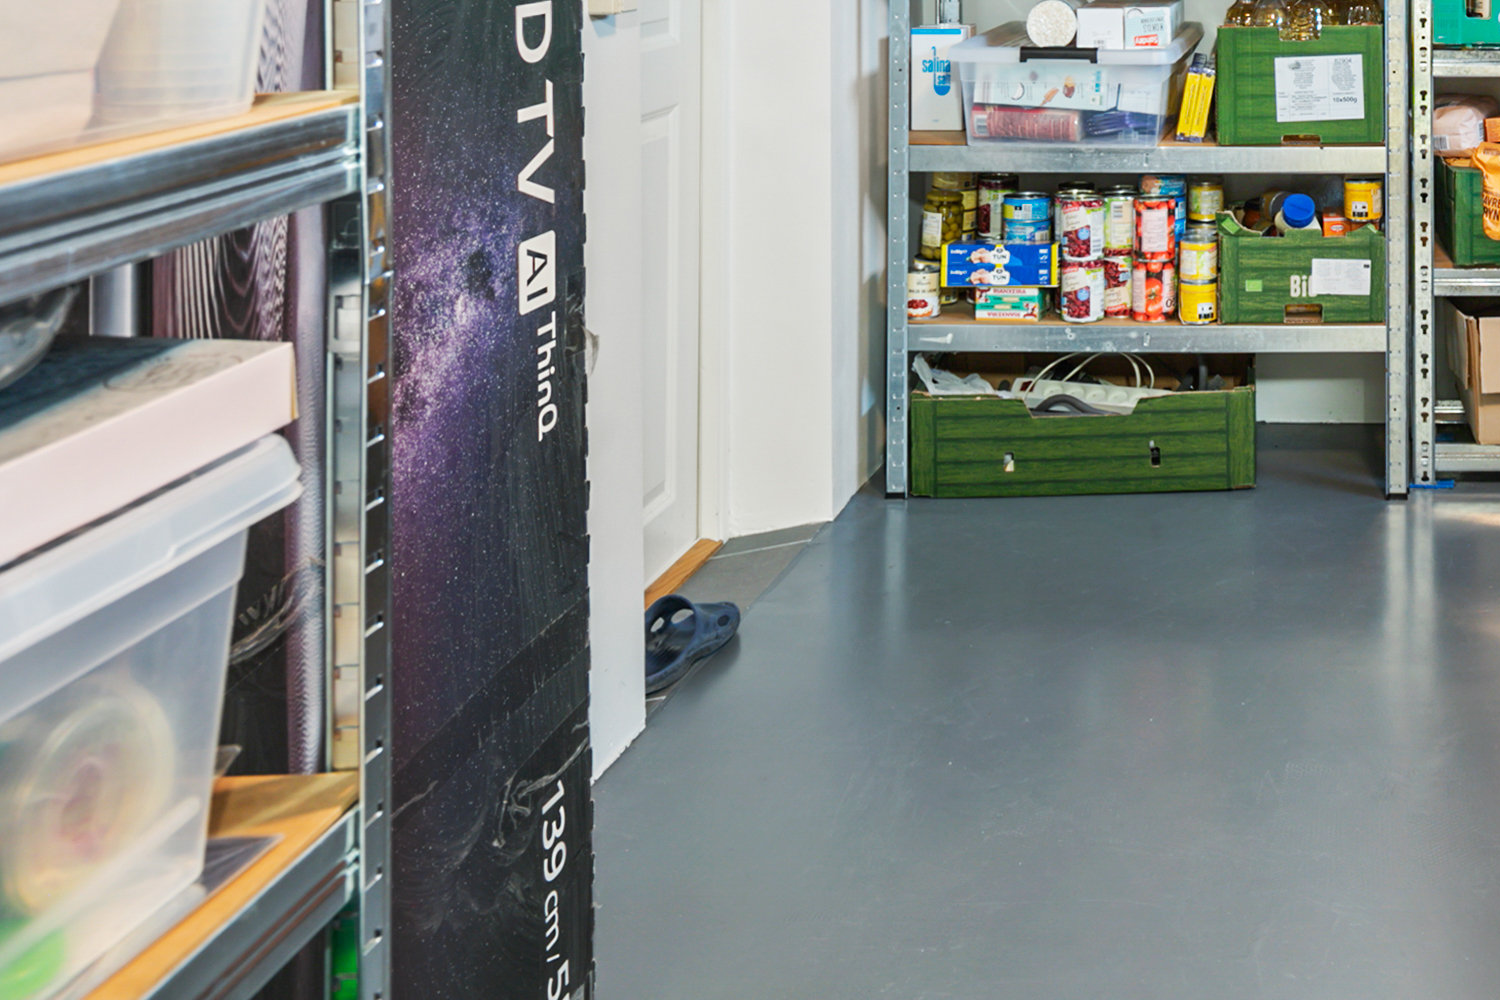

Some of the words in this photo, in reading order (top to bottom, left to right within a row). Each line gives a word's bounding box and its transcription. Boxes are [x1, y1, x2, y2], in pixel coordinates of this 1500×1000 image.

[922, 57, 951, 73] salina
[516, 79, 555, 204] TV
[536, 311, 558, 442] ThinQ
[541, 779, 567, 882] 139
[543, 890, 559, 951] cm
[547, 959, 570, 1000] 5
